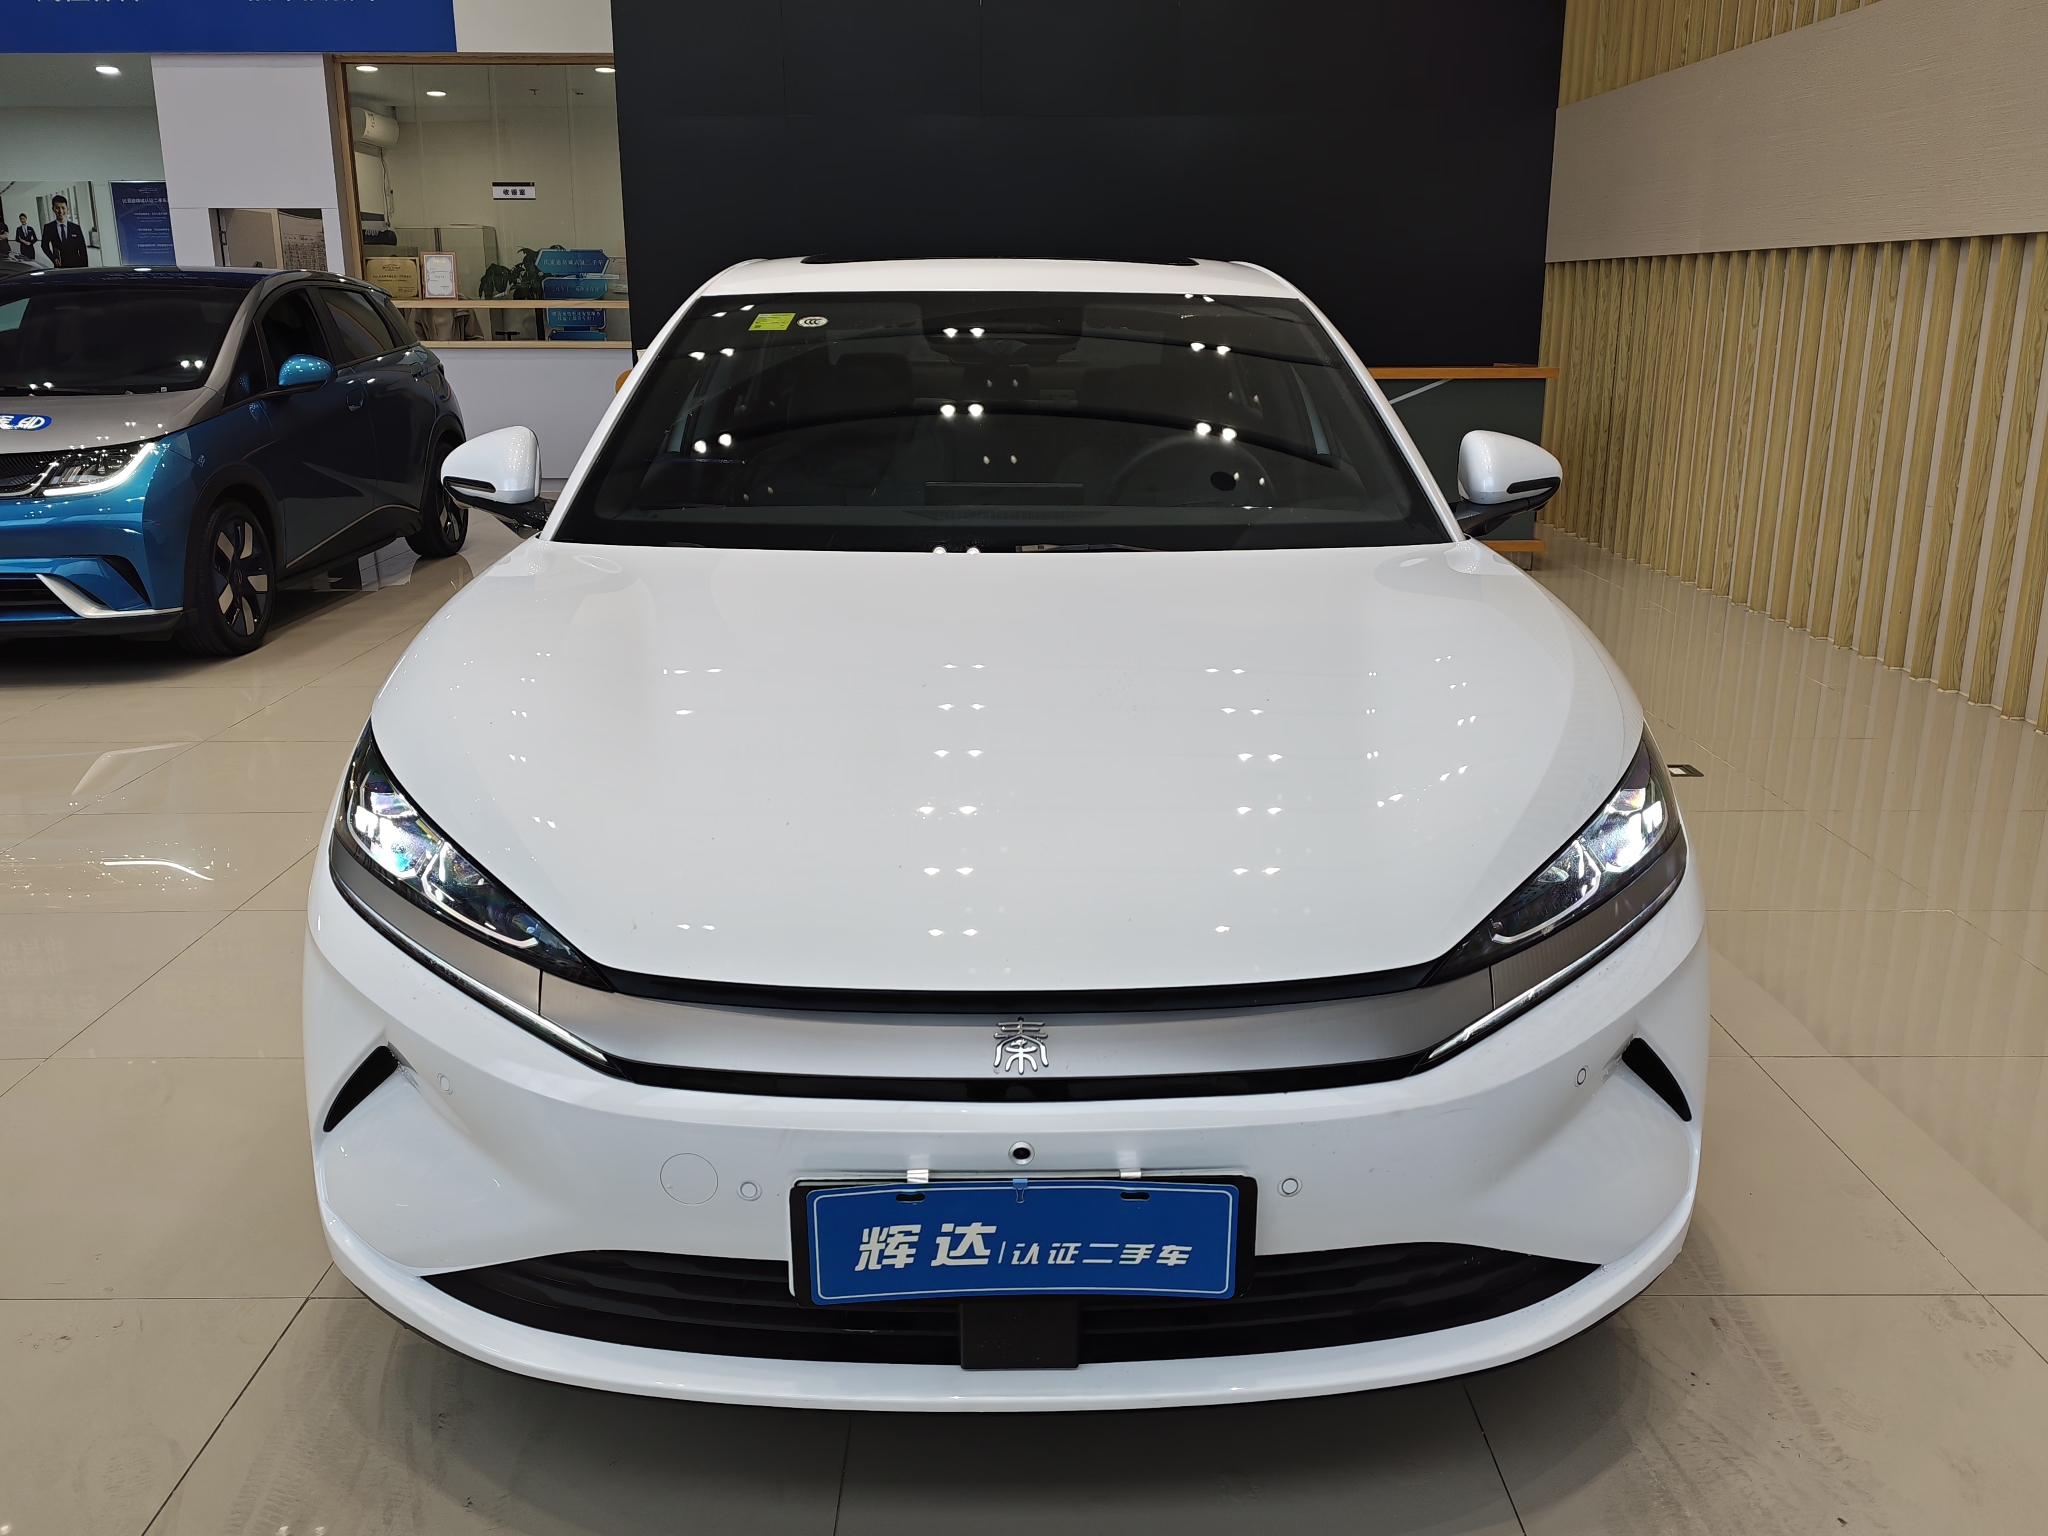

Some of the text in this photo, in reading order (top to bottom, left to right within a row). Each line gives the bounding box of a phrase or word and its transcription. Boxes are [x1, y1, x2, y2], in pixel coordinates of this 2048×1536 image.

[502, 188, 526, 196] 收银室
[993, 1016, 1049, 1075] 秦
[854, 1221, 1193, 1272] 辉达 认证二手车
